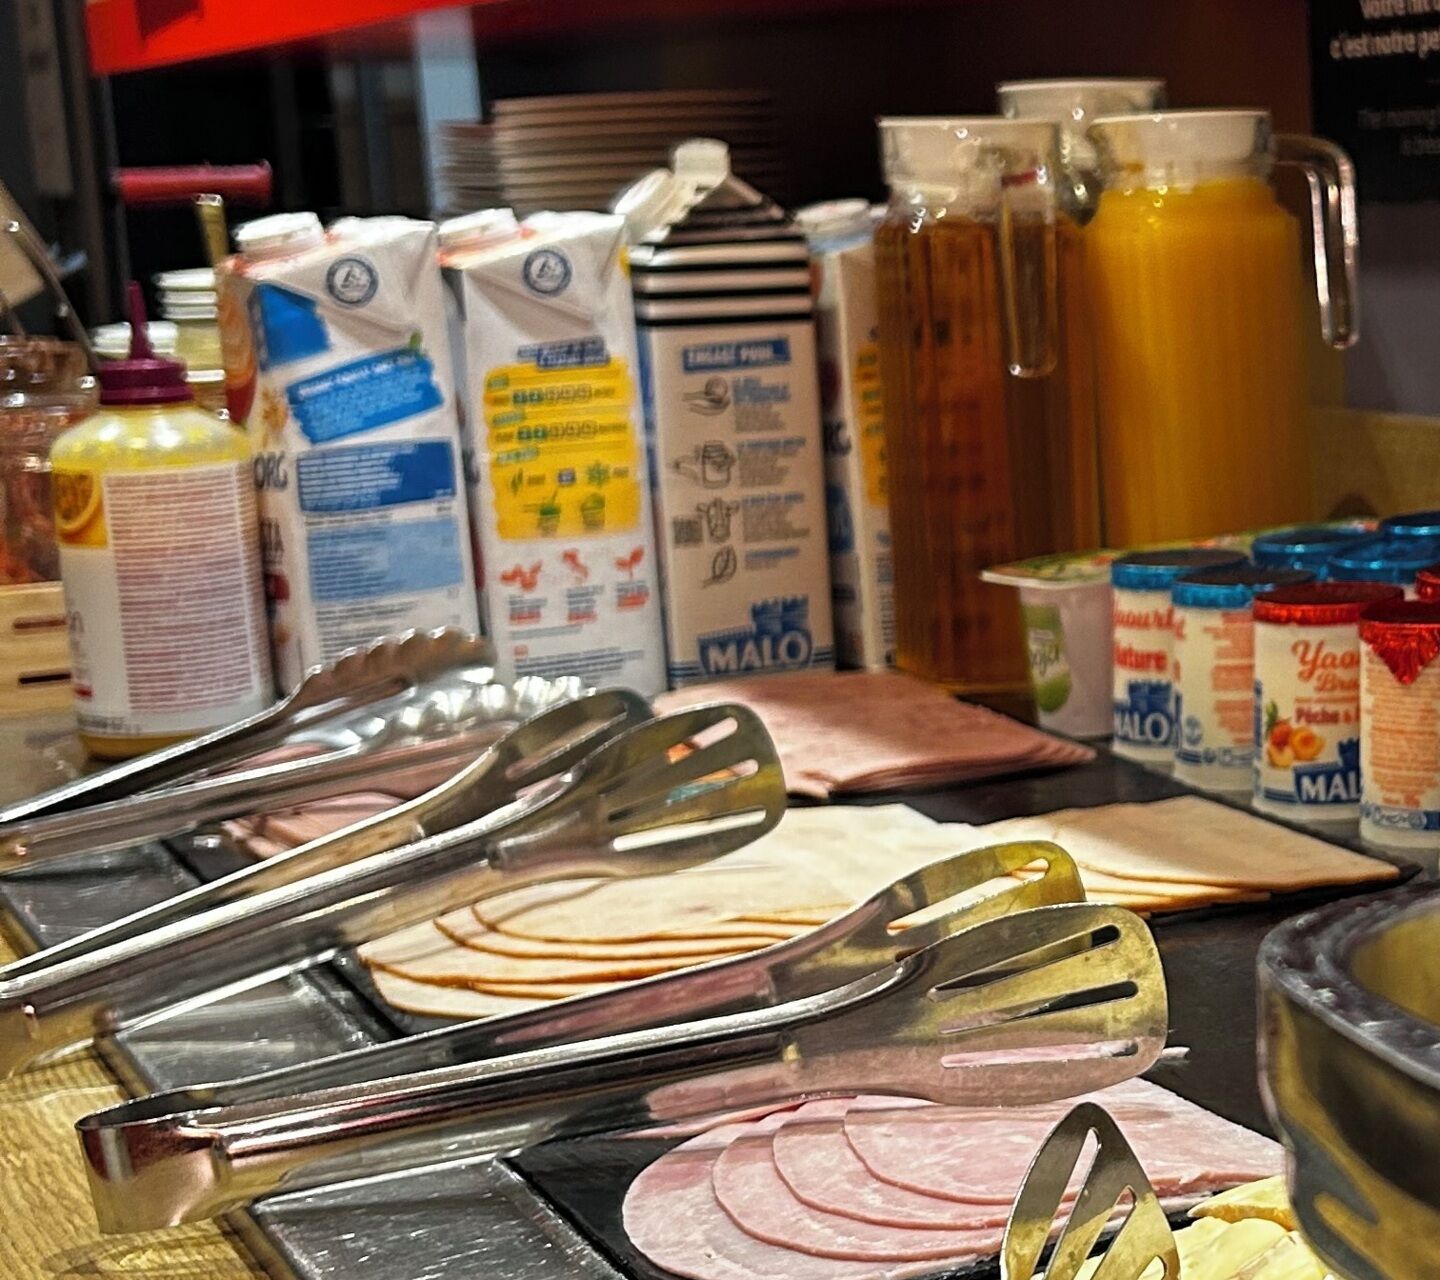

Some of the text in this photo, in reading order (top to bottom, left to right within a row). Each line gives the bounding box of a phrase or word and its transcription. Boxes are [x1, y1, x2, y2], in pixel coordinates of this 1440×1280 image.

[706, 629, 806, 673] MALO
[1114, 644, 1168, 673] ature
[1291, 639, 1361, 682] Yao
[1301, 772, 1362, 802] MAL
